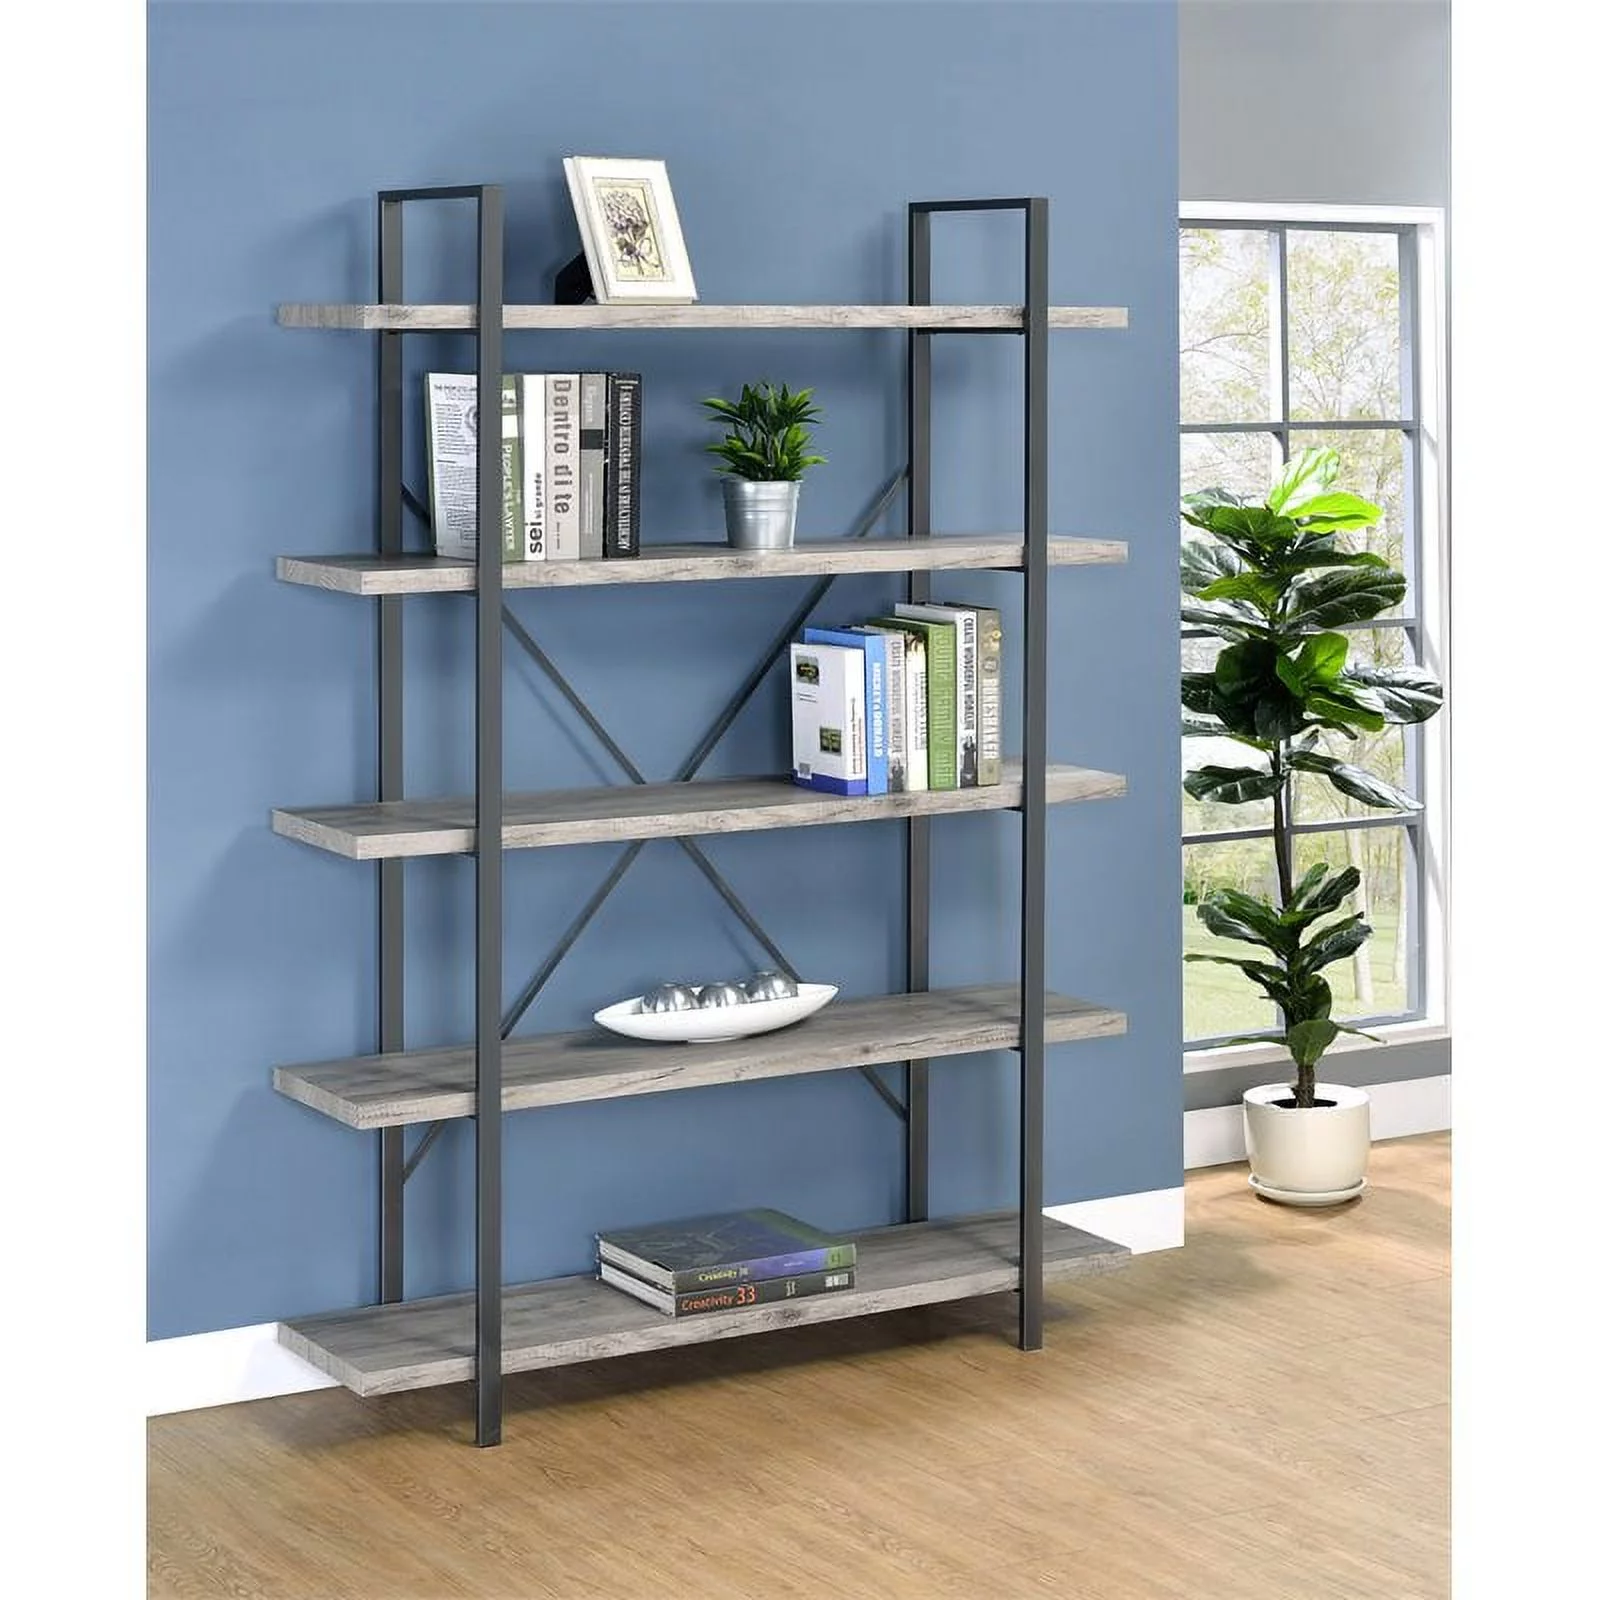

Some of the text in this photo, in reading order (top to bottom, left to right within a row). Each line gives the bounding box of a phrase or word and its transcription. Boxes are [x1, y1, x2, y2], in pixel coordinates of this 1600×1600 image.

[553, 379, 573, 514] Dentro di te
[525, 521, 542, 553] sei
[736, 1286, 756, 1305] 33
